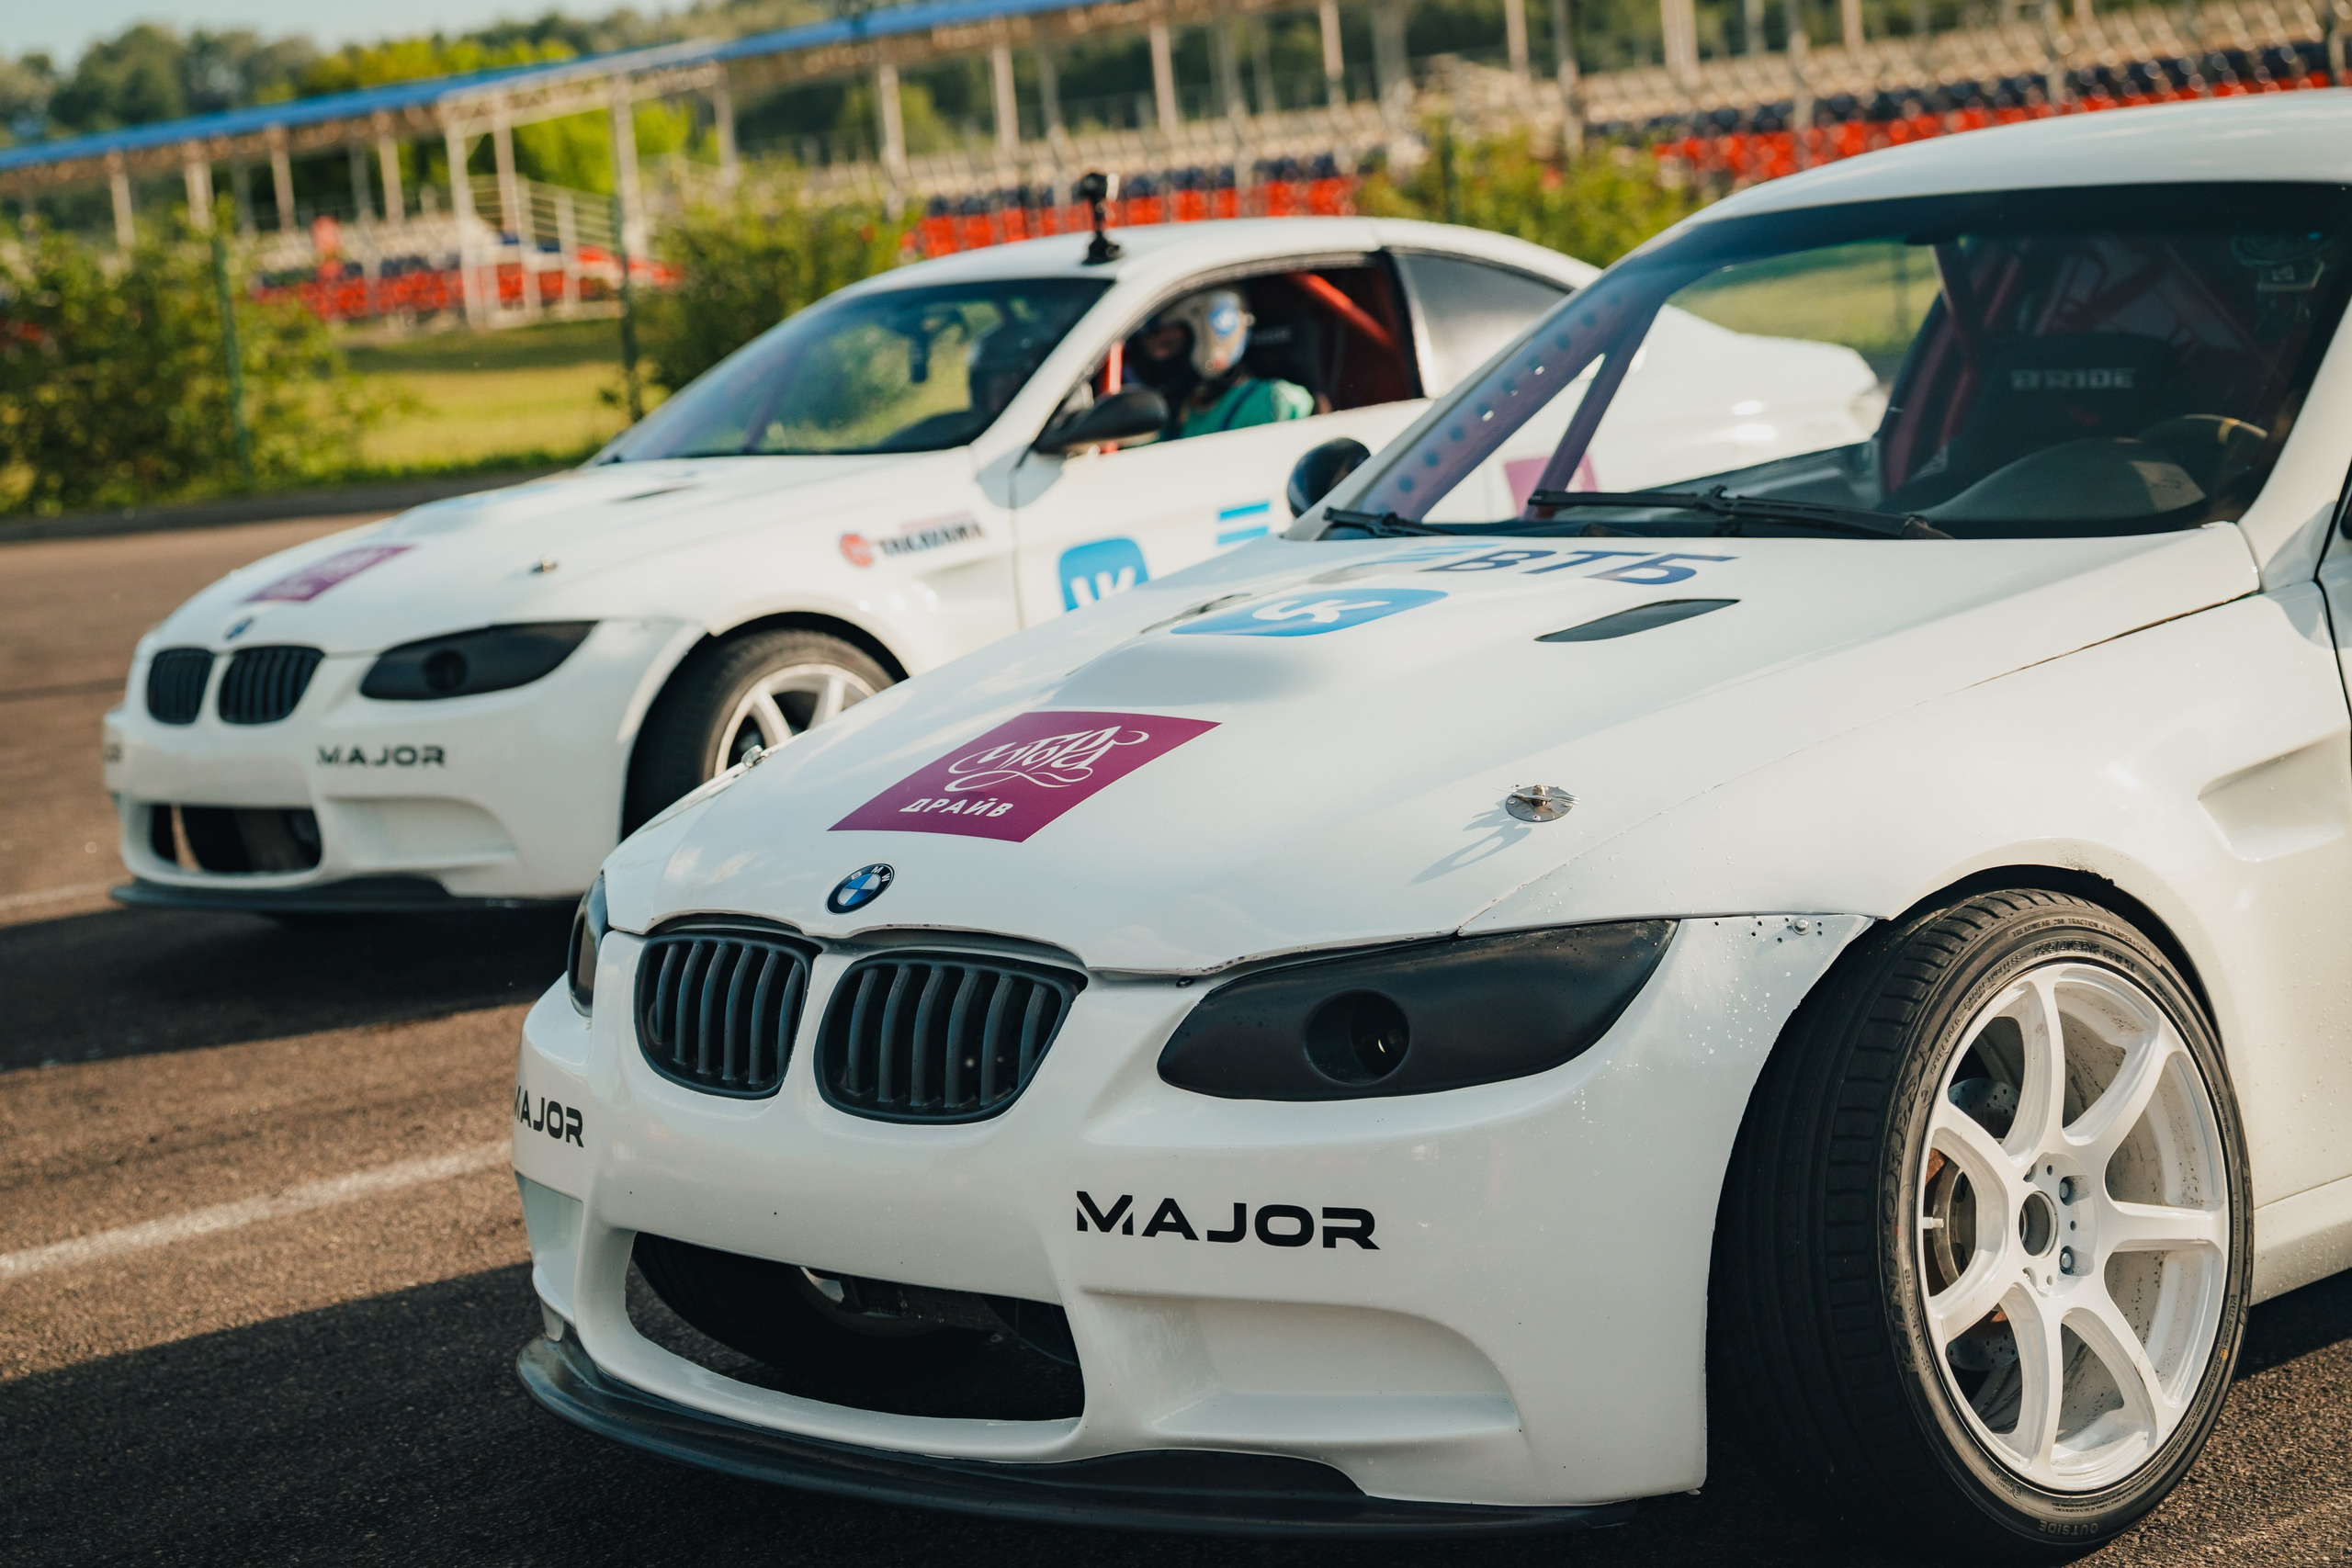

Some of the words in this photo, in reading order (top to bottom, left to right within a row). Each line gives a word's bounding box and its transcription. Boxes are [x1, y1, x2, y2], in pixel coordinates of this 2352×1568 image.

[2011, 369, 2134, 389] BRIDE
[317, 744, 446, 767] MAJOR
[899, 797, 1014, 818] ДРАЙВ
[851, 865, 891, 882] BMW
[1076, 1190, 1381, 1250] MAJOR
[2039, 1519, 2098, 1536] OUTSIDE
